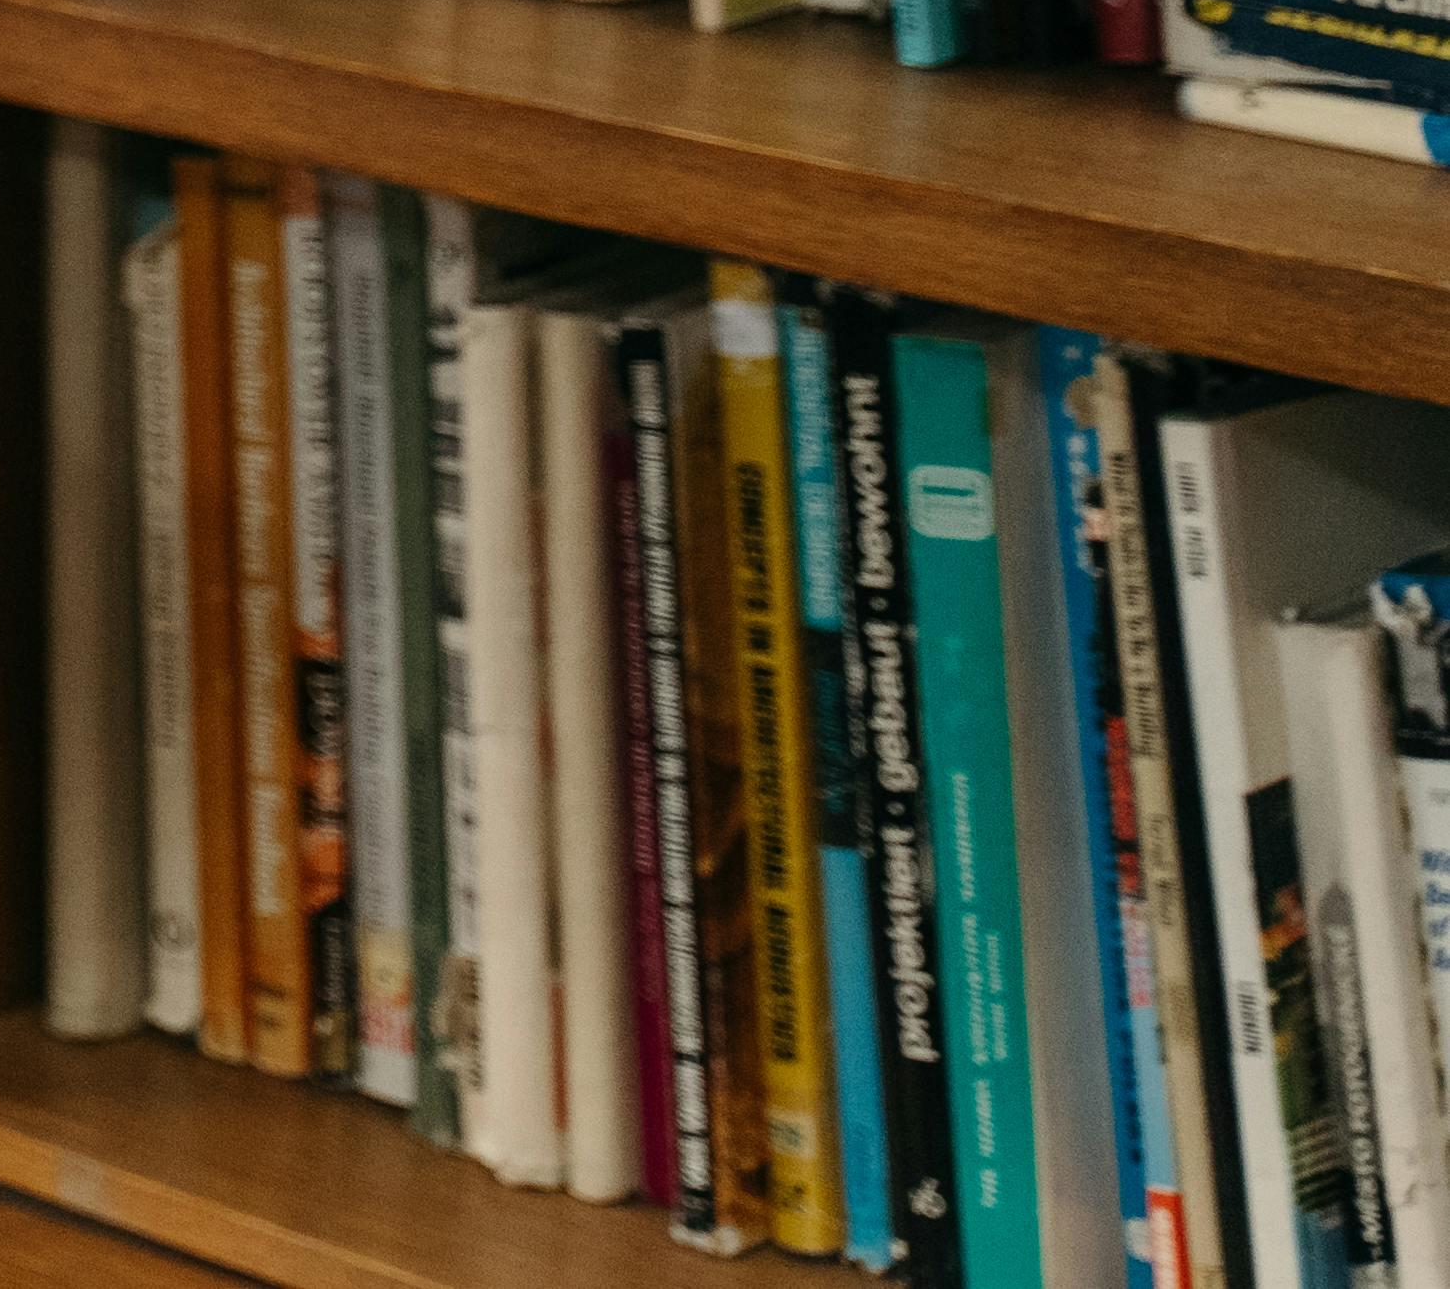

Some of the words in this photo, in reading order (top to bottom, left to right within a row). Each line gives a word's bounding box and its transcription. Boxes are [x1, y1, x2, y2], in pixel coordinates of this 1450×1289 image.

[842, 370, 897, 591] bewohnt
[854, 619, 916, 792] gebaut
[877, 825, 941, 1064] projektiert
